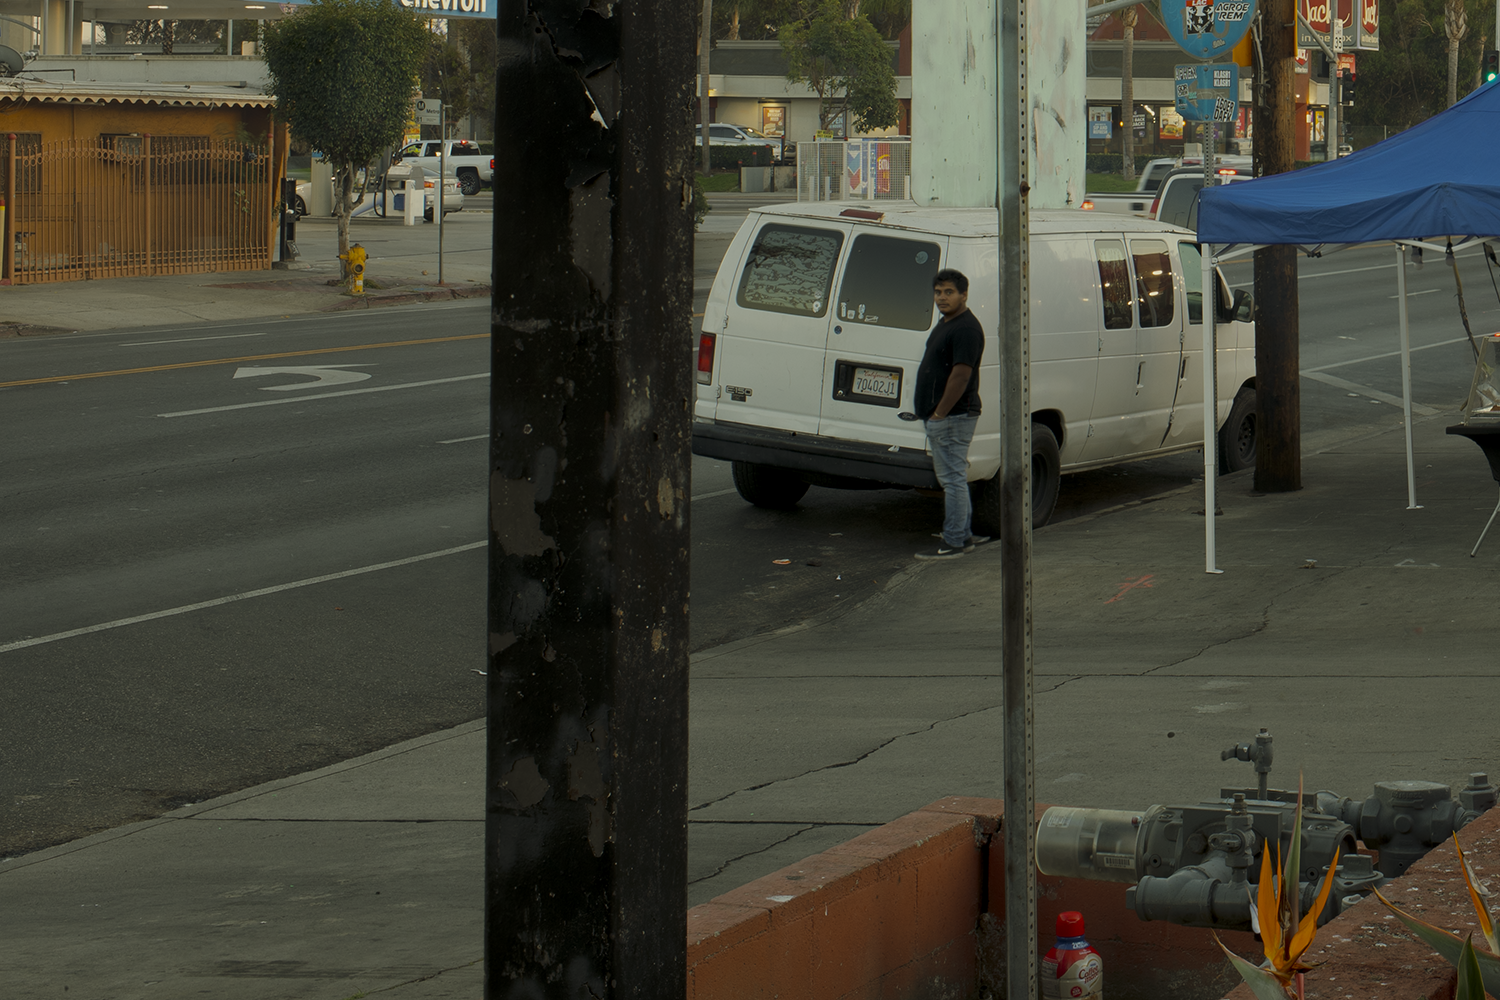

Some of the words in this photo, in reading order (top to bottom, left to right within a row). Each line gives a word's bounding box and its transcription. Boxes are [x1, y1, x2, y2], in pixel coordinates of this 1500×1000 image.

[1215, 2, 1251, 13] AGROE
[1217, 12, 1245, 21] REM
[1334, 37, 1342, 49] 35
[857, 377, 895, 395] 70402J1
